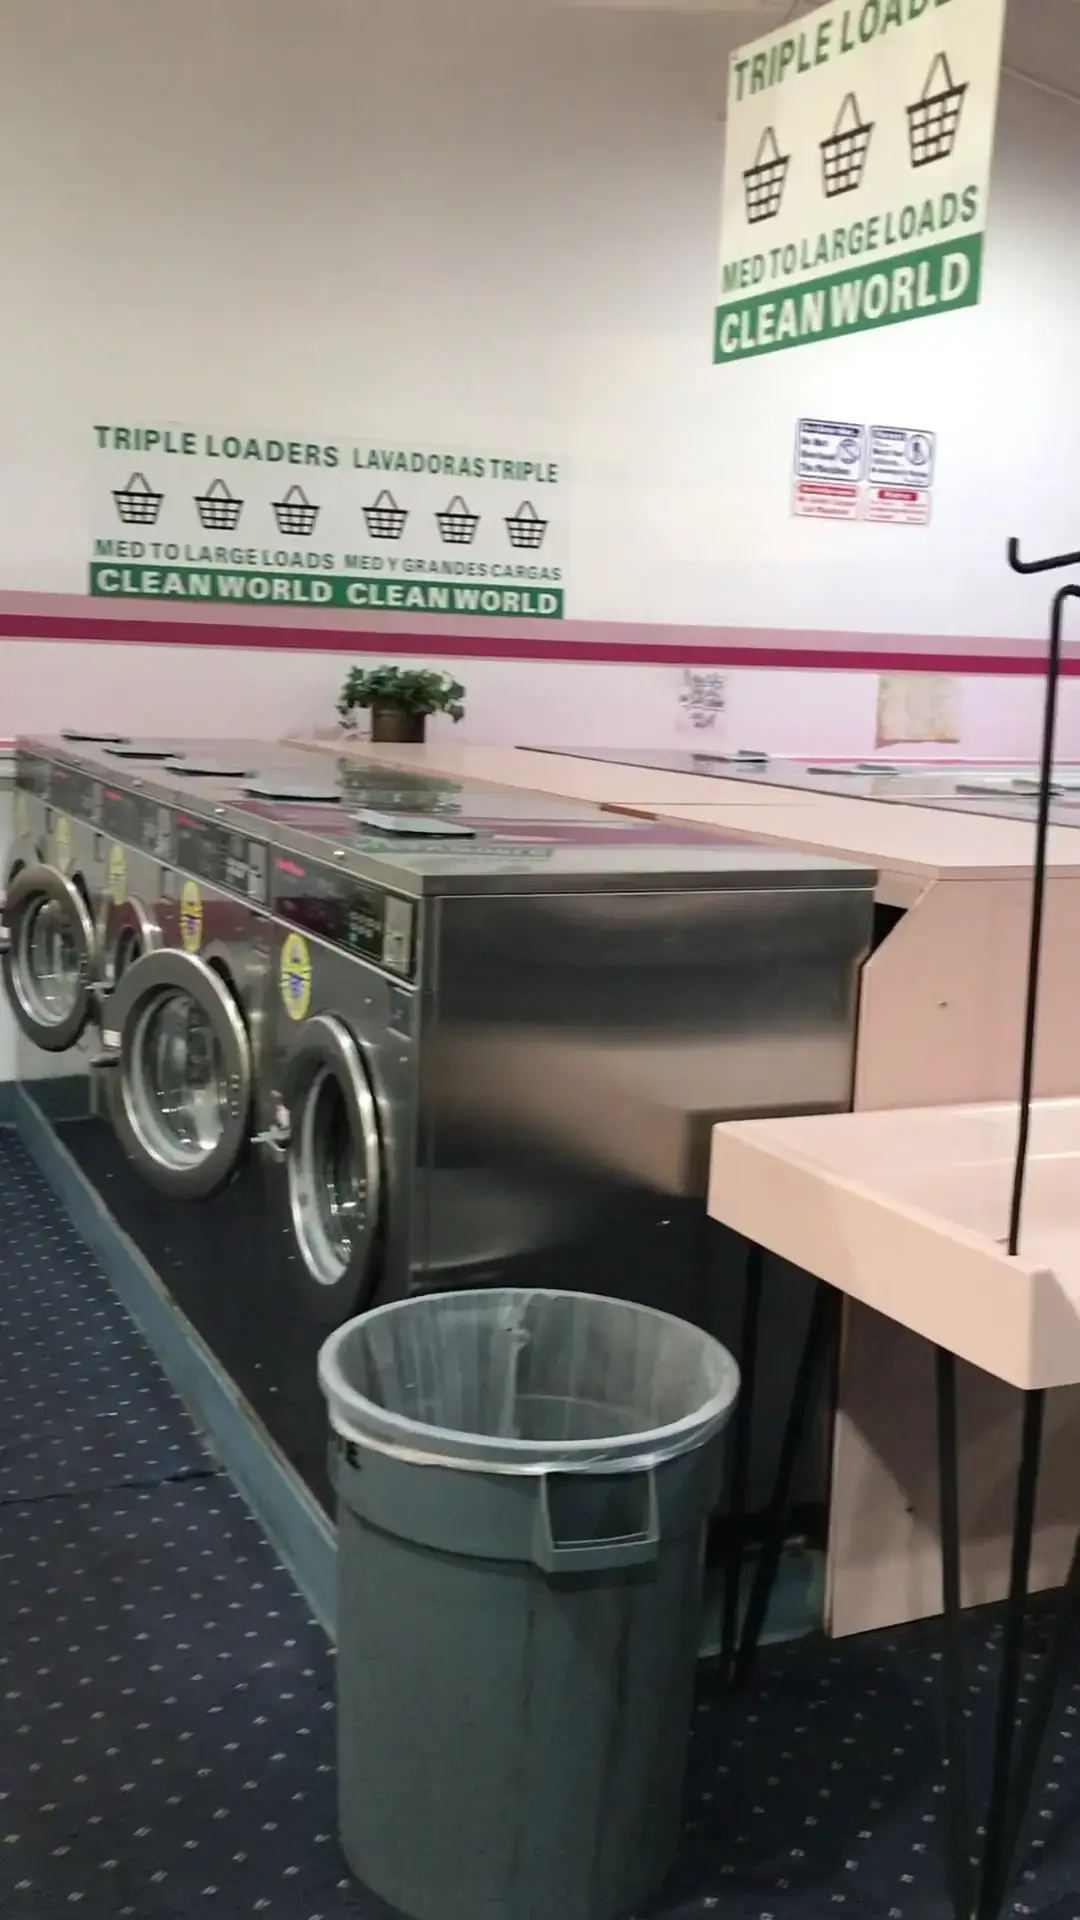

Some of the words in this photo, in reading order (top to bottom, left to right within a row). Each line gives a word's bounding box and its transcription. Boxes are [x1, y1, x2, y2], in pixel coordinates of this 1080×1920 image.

[734, 19, 833, 101] TRIPLE
[839, 0, 952, 54] LOA
[722, 254, 765, 293] MED
[769, 244, 797, 281] TO
[801, 216, 880, 270] LARGE
[884, 185, 978, 245] LOADS
[719, 290, 825, 354] CLEAN
[830, 252, 971, 328] WORLD
[94, 425, 198, 455] TRIPLE
[205, 434, 338, 468] LOADERS
[353, 448, 485, 478] LAVADORAS
[490, 458, 559, 483] TRIPLE
[95, 539, 145, 559] MED
[150, 542, 180, 561] TO
[185, 544, 258, 566] LARGE
[262, 549, 335, 570] LOADS
[344, 553, 382, 571] MED
[388, 557, 399, 571] Y
[403, 557, 488, 578] GRANDES
[491, 563, 562, 581] CARGAS
[96, 568, 211, 596] CLEAN
[215, 574, 334, 603] WORLD
[346, 582, 449, 609] CLEAN
[453, 588, 558, 615] WORLD
